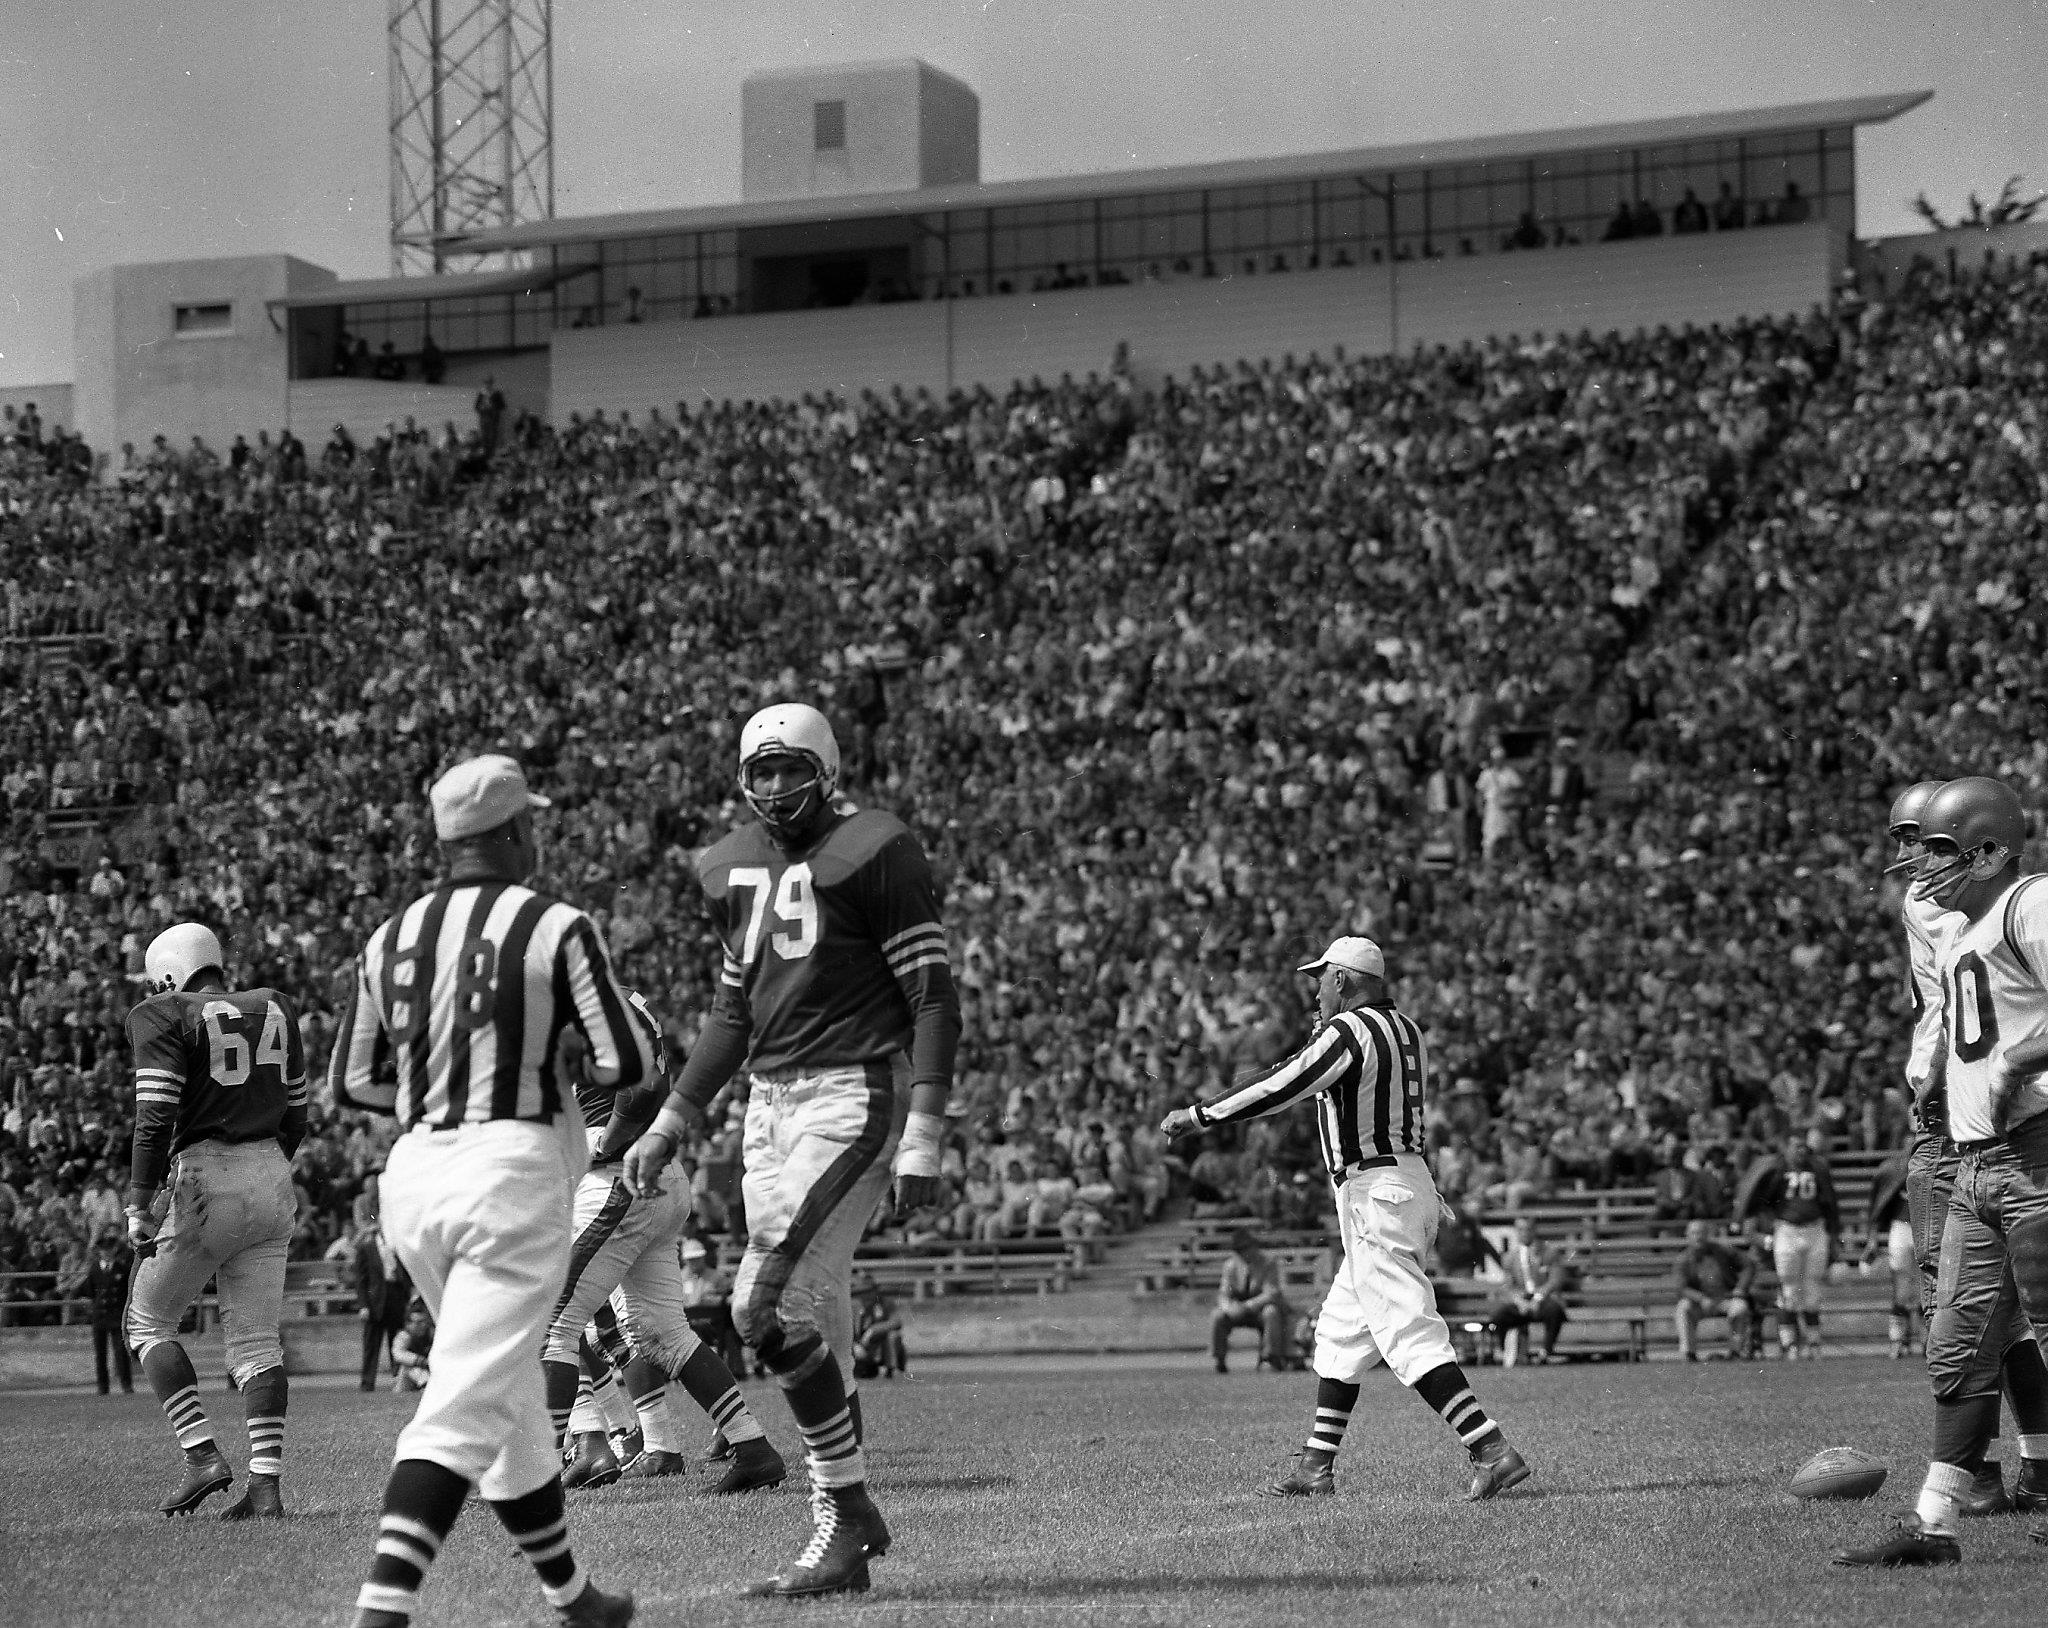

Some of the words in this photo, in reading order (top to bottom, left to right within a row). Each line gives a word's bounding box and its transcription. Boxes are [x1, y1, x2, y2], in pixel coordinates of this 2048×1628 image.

[727, 861, 818, 964] 79
[201, 1000, 290, 1086] 64
[1940, 949, 2000, 1063] 0
